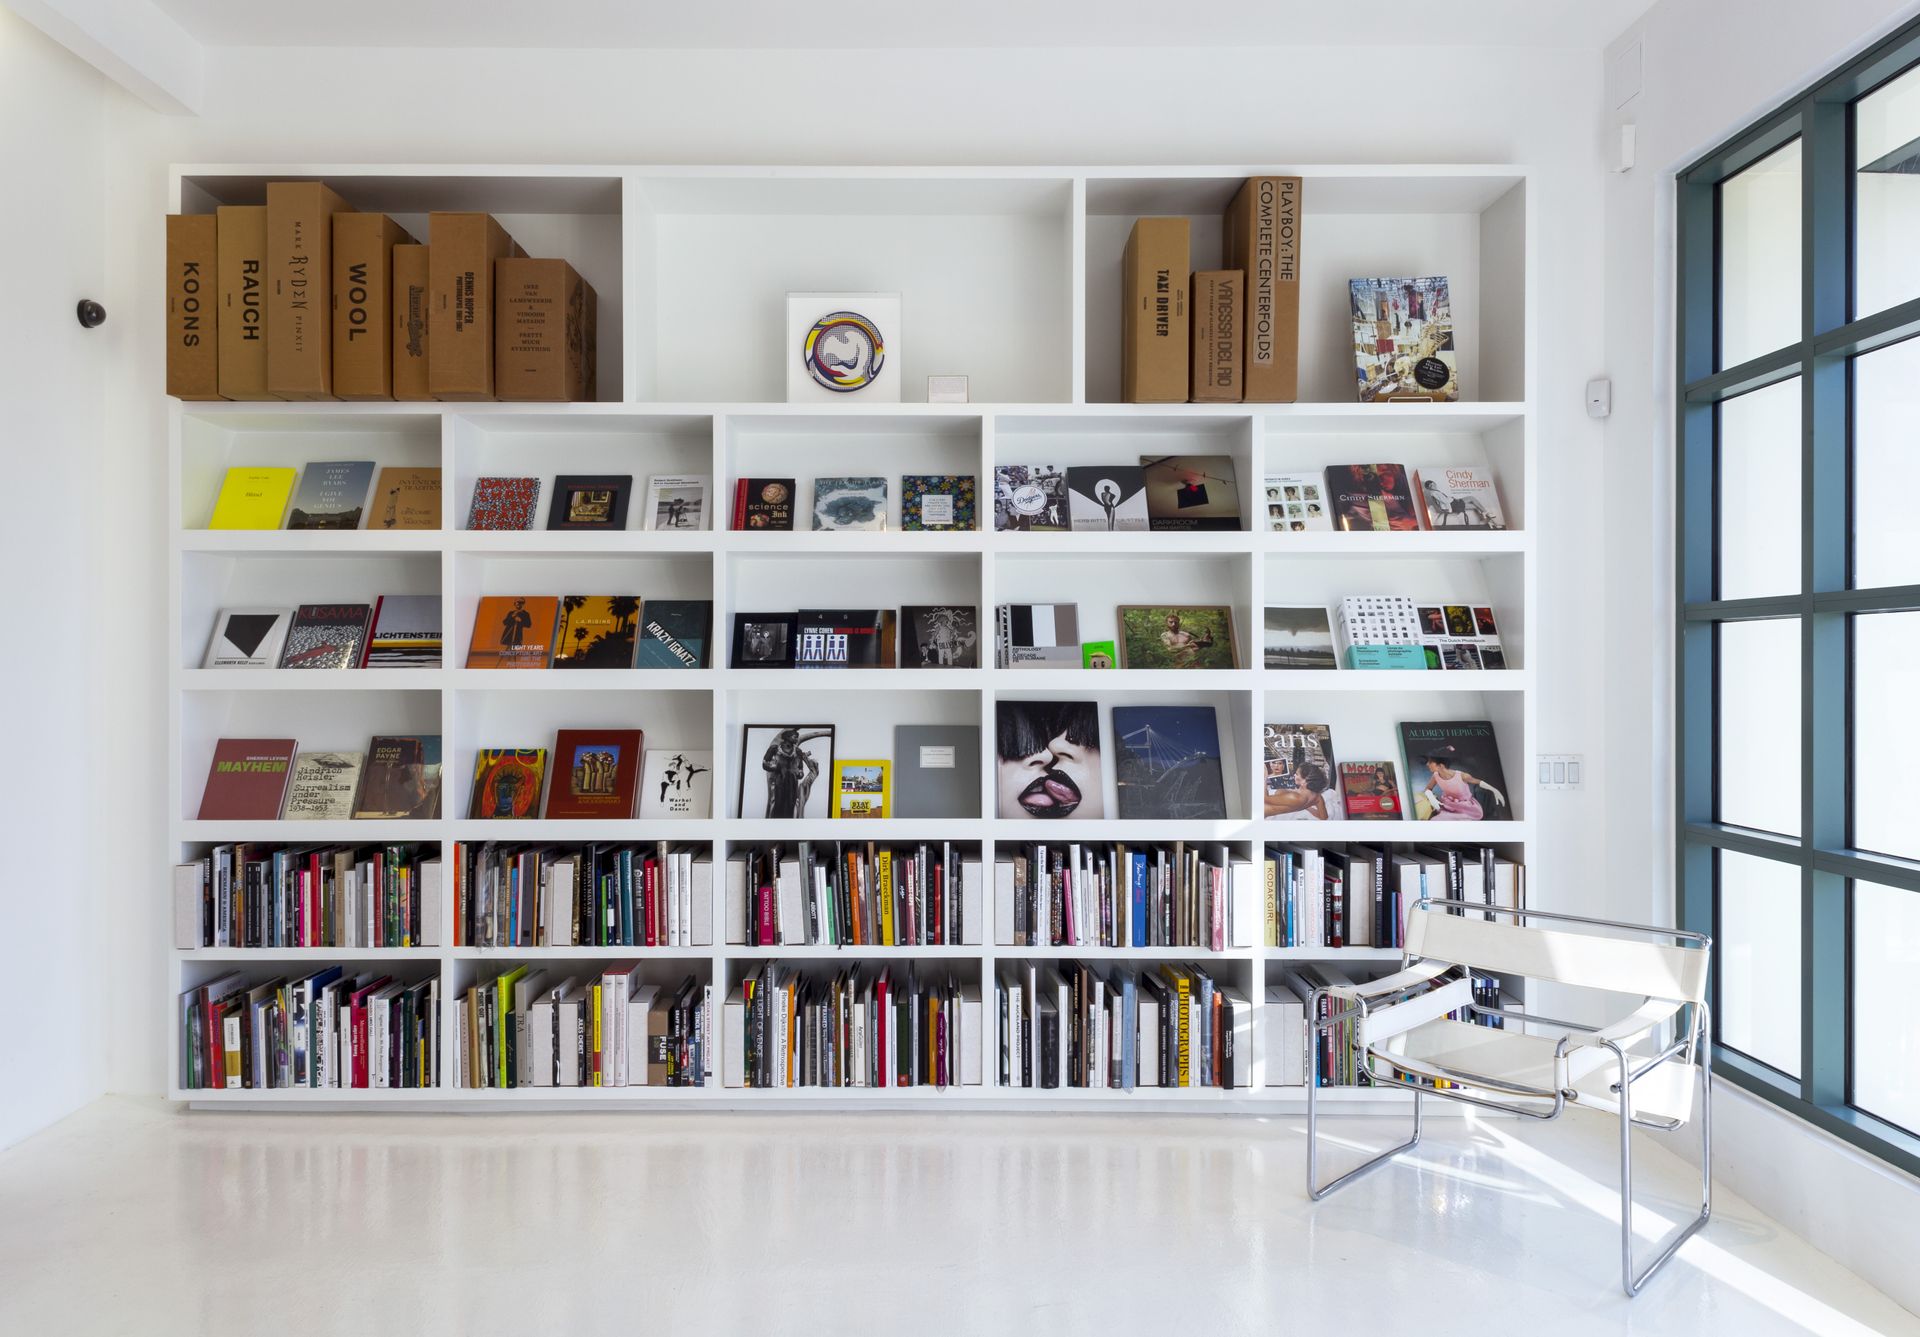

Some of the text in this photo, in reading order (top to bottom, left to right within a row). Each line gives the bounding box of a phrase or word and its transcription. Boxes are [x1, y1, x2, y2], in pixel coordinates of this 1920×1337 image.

[1281, 182, 1293, 280] PLAYBOY: THE
[1257, 181, 1272, 360] COMPLETE CENTERFOLDS
[184, 262, 200, 347] KOONS
[243, 260, 259, 341] RAUCH
[349, 263, 367, 342] WOOL
[464, 272, 474, 324] DENNIS HOPPER
[1156, 269, 1170, 337] TAXI DRIVER
[1217, 280, 1233, 386] VANESSA DEL RIO
[1016, 494, 1042, 504] Dodgers
[1446, 470, 1473, 480] Cindy
[1449, 480, 1490, 488] Sherman
[300, 607, 364, 619] KUSAMA
[646, 620, 696, 667] KRAZY IGNATZ
[1264, 726, 1319, 750] Paris
[1408, 728, 1490, 737] AUDREY HEPBURN
[217, 761, 287, 772] MAYHEM
[757, 1022, 763, 1032] OF
[1179, 992, 1189, 1076] PHOTOGRAPHS
